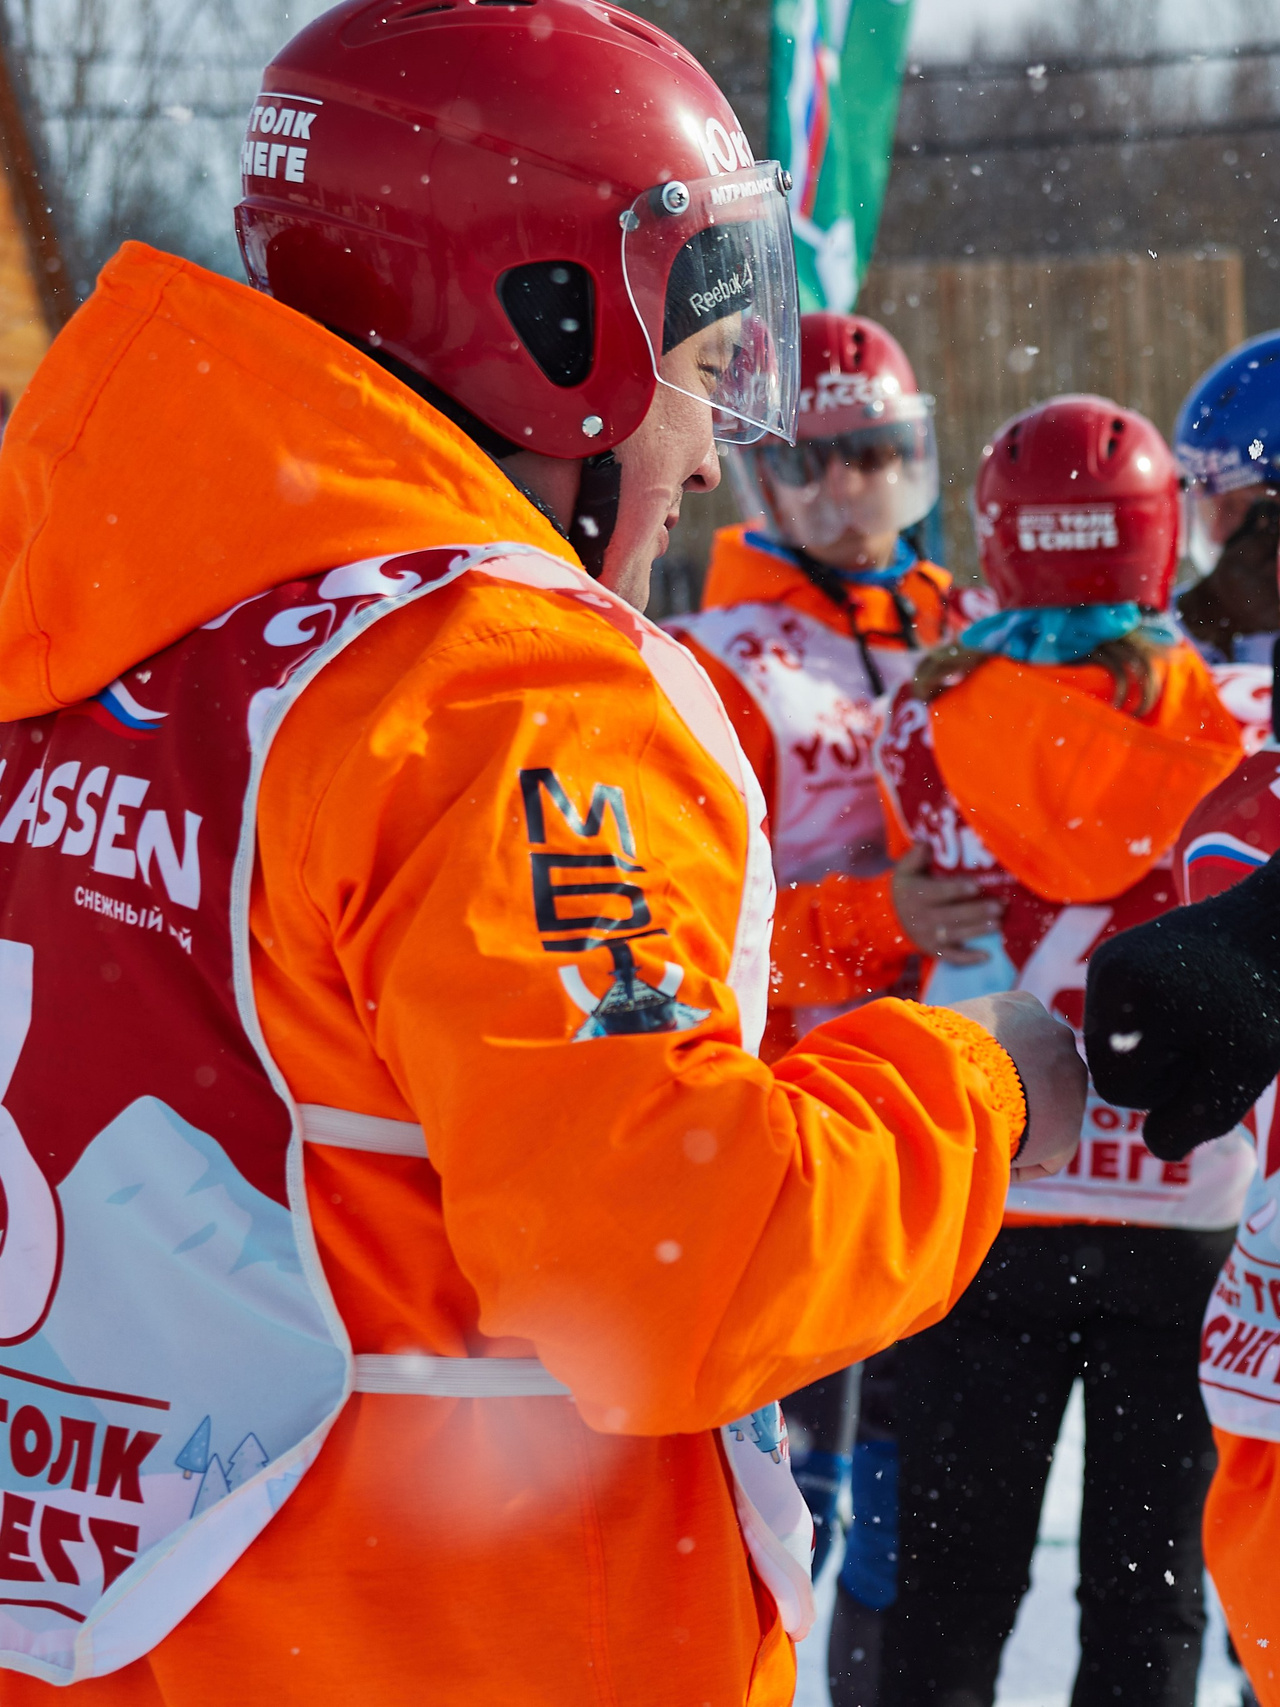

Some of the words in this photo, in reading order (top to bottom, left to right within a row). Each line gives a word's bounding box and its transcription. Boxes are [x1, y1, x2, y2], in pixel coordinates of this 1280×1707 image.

[251, 105, 318, 141] ТОЛК
[242, 140, 308, 184] НЕГЕ
[689, 271, 744, 317] Reebok
[0, 759, 203, 911] ASSEN
[74, 885, 164, 933] СНЕЖНЫЙ
[0, 1397, 163, 1505] ОЛК
